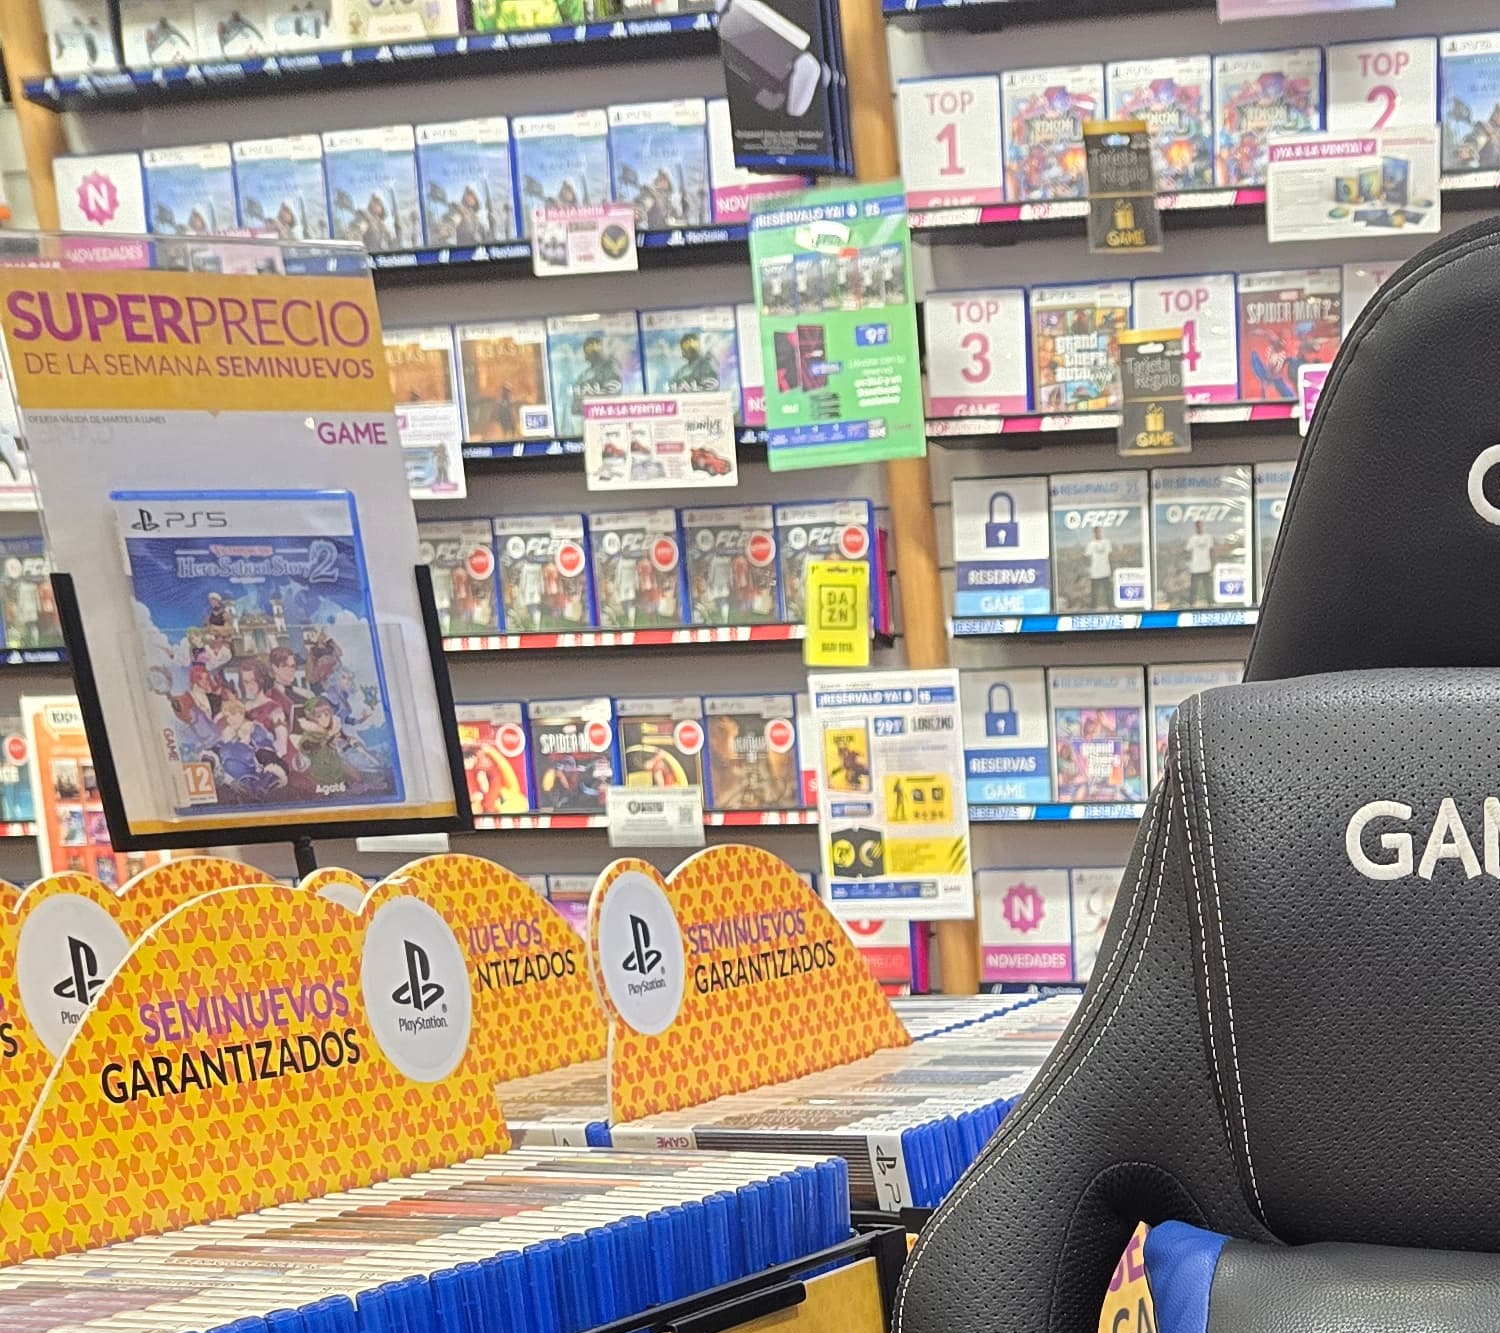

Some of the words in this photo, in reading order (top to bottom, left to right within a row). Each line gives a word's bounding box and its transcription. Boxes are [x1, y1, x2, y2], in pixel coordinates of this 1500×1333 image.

[1358, 52, 1410, 77] TOP
[926, 91, 974, 114] TOP
[936, 123, 965, 177] 1
[1107, 229, 1146, 247] GAME
[952, 300, 999, 323] TOP
[1160, 289, 1209, 313] TOP
[8, 289, 370, 348] SUPERPRECIO
[24, 352, 61, 374] DE
[67, 353, 99, 375] LA
[104, 353, 211, 377] SEMANA
[217, 355, 374, 379] SEMINUEVOS
[960, 333, 992, 384] 3
[28, 415, 60, 423] OFERTA
[317, 421, 388, 445] GAME
[1136, 432, 1175, 448] GAME
[165, 511, 228, 528] PS5
[309, 540, 339, 583] 2
[968, 568, 1036, 585] RESERVAS
[980, 596, 1025, 612] GAME
[164, 727, 179, 763] GAME
[971, 757, 1036, 772] RESERVAS
[185, 765, 212, 793] 12
[985, 785, 1026, 798] GAME
[688, 908, 807, 957] SEMINUEVOS
[695, 940, 836, 994] GARANTIZADOS
[985, 952, 1067, 968] NOVEDADES
[627, 977, 666, 996] PlayStation
[139, 980, 350, 1044] SEMINUEVOS
[398, 1014, 447, 1035] PlayStation
[100, 1028, 361, 1104] GARANTIZADOS
